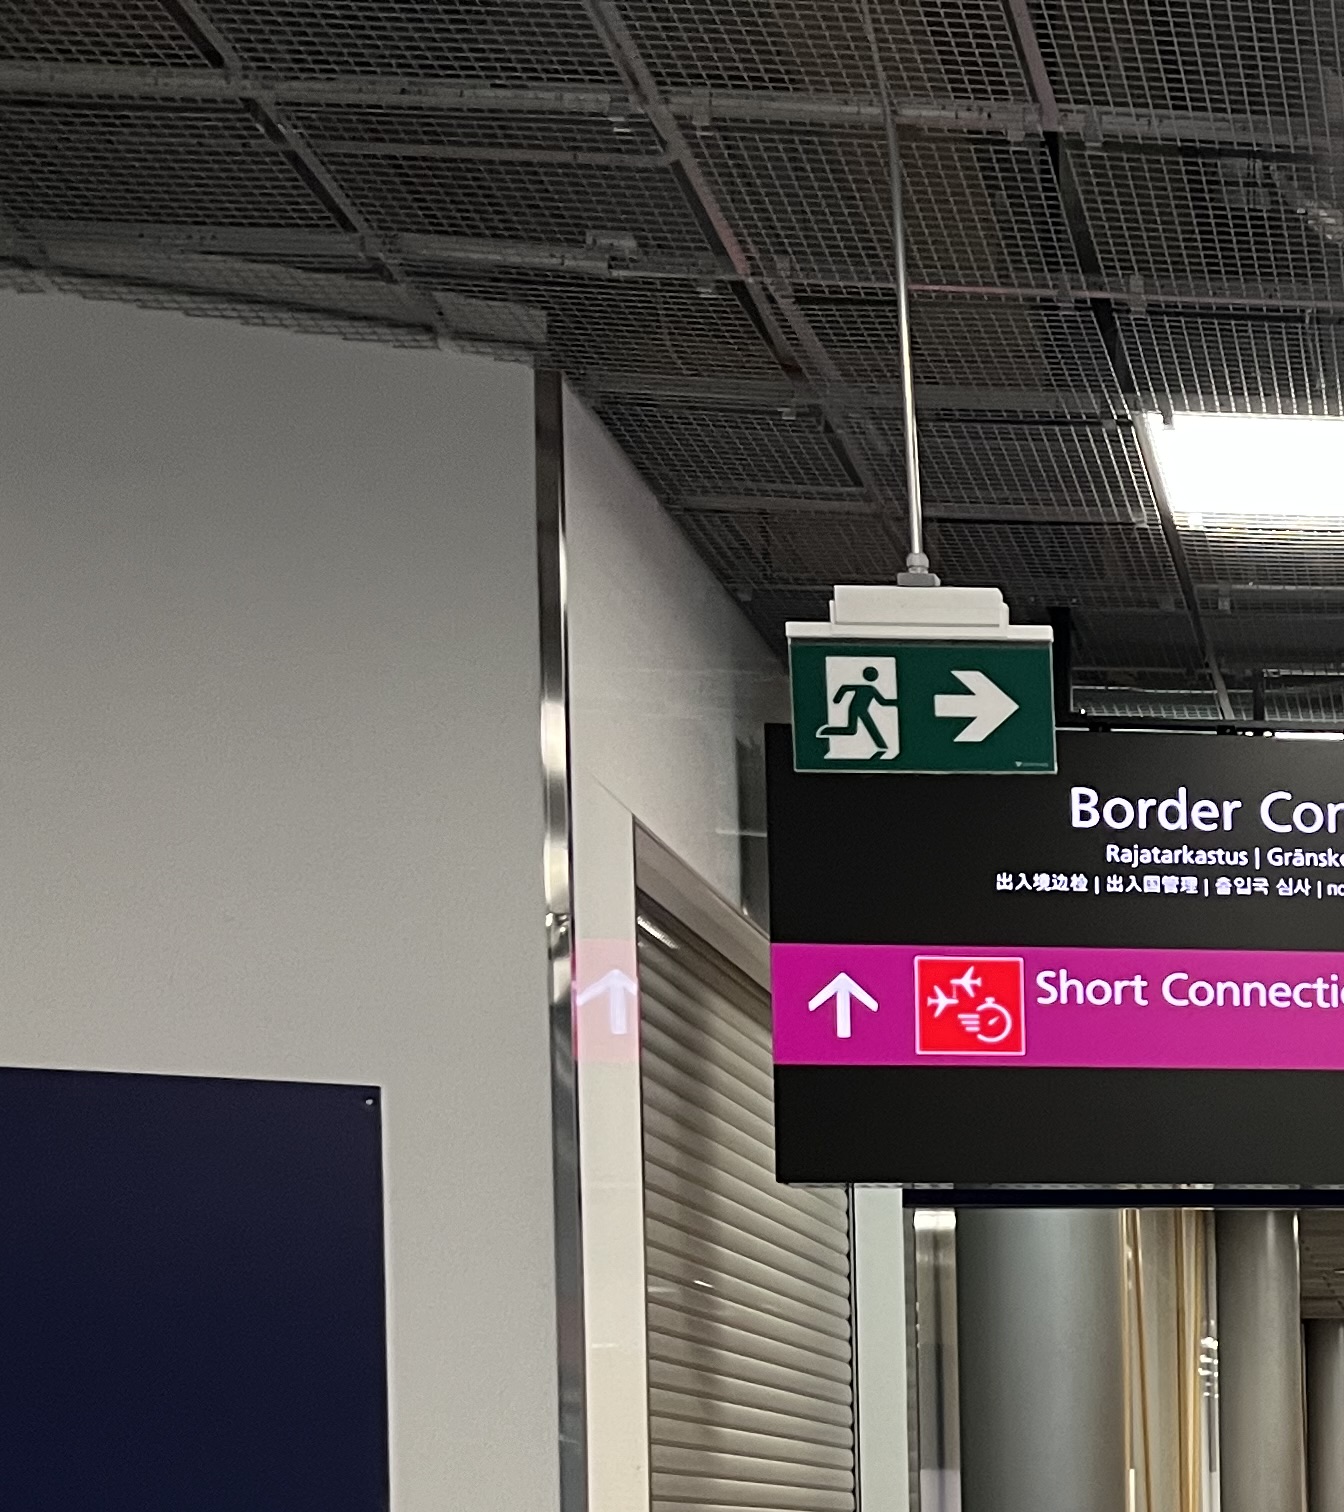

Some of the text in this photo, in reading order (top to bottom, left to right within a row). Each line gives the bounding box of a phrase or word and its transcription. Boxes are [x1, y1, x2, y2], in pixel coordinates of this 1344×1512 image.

[1070, 786, 1242, 831] Border
[1106, 844, 1249, 868] Rajatarkastus
[1215, 876, 1311, 896] 출입국 심사
[1036, 968, 1148, 1006] Short
